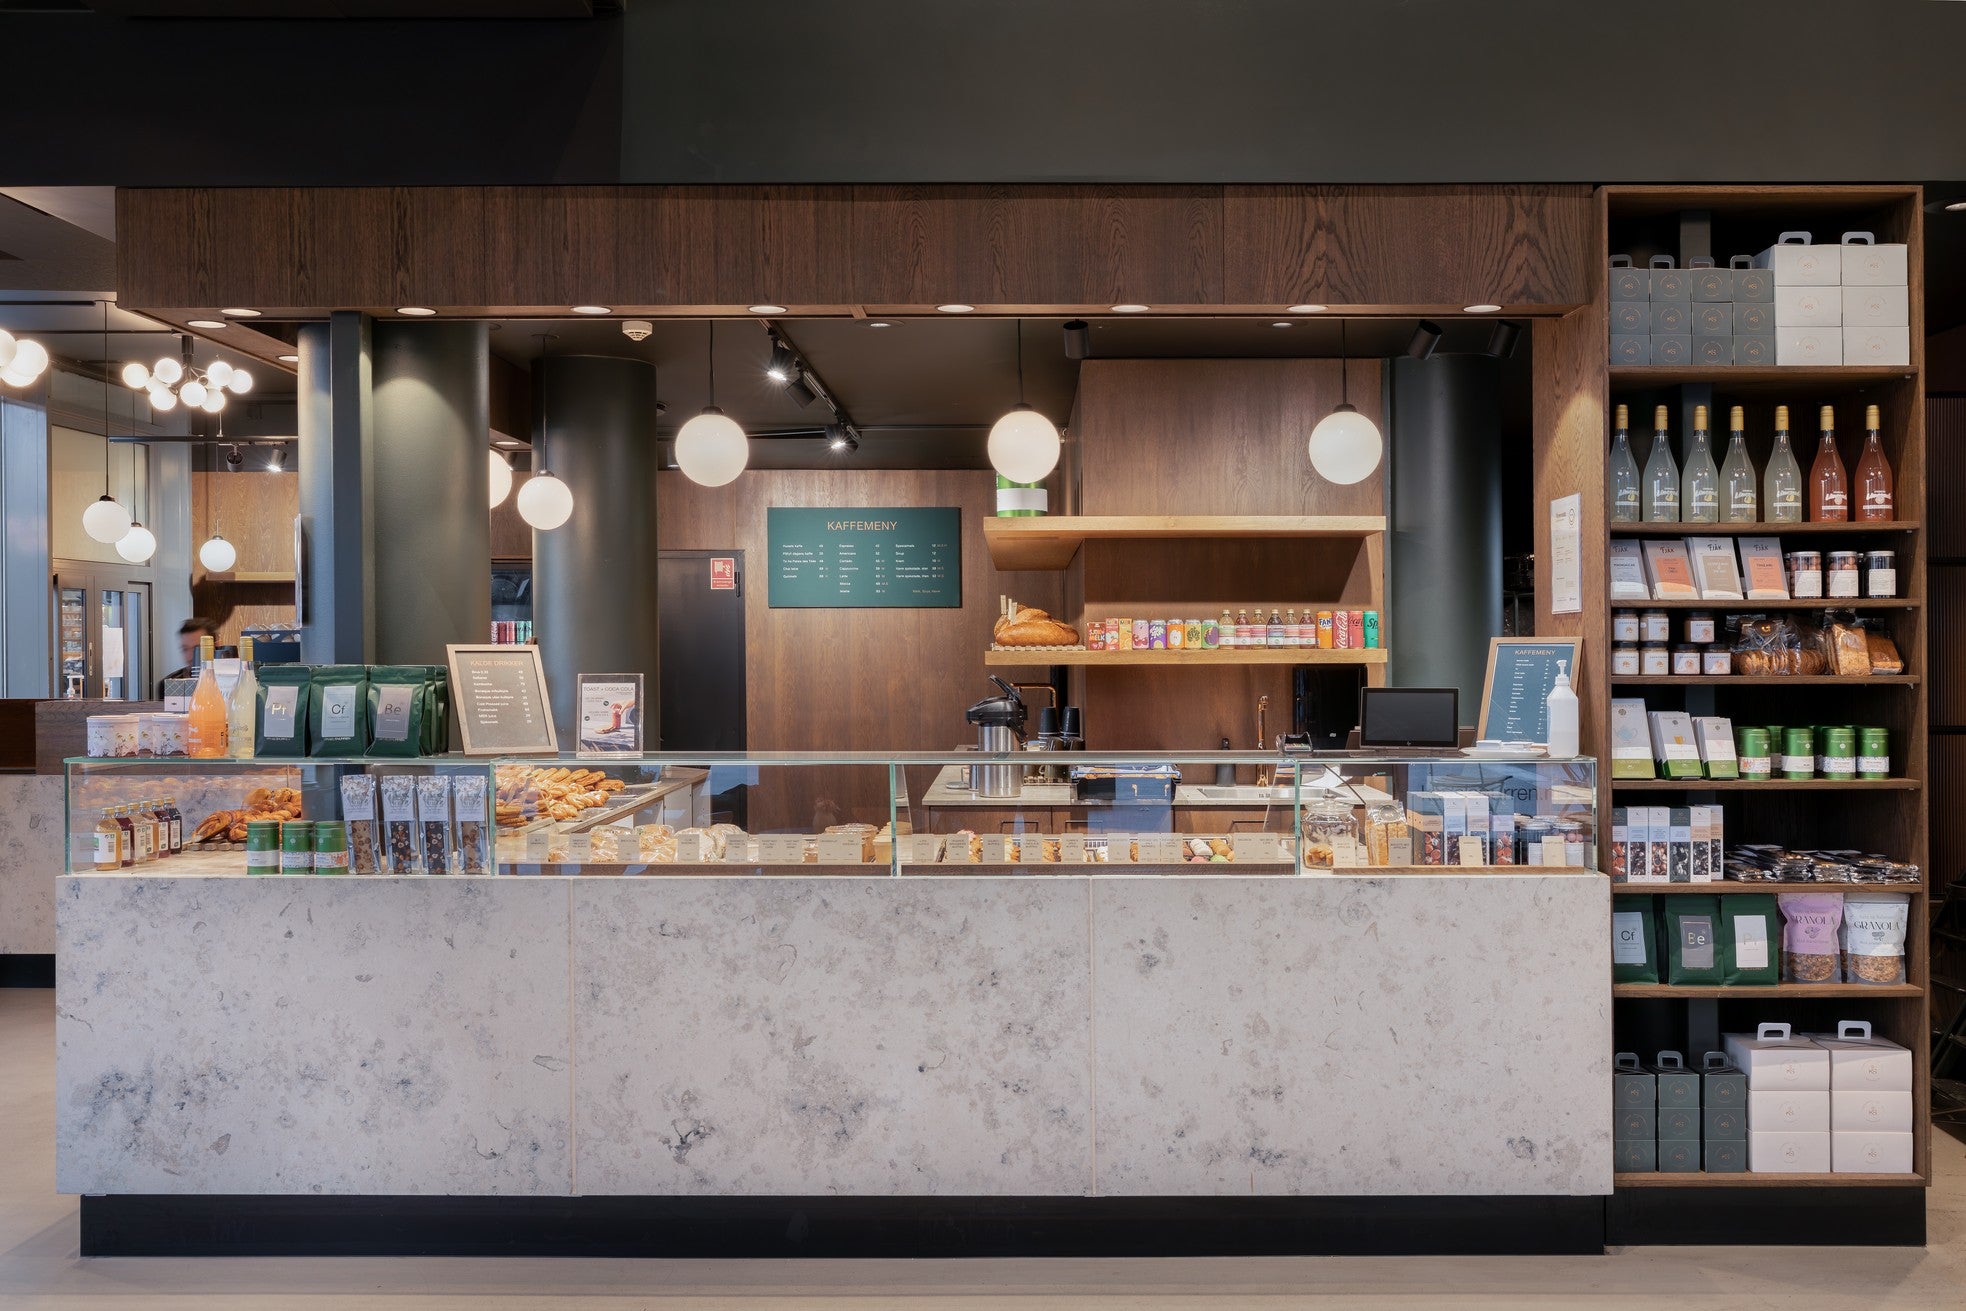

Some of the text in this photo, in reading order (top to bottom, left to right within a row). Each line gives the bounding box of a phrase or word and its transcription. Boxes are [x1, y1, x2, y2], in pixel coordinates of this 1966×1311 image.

[827, 521, 897, 531] KAFFEMENY
[331, 704, 346, 715] Cf
[384, 703, 402, 716] Be
[1853, 921, 1900, 930] GRANOLA
[1620, 930, 1635, 941] Cf
[1687, 932, 1706, 945] Be
